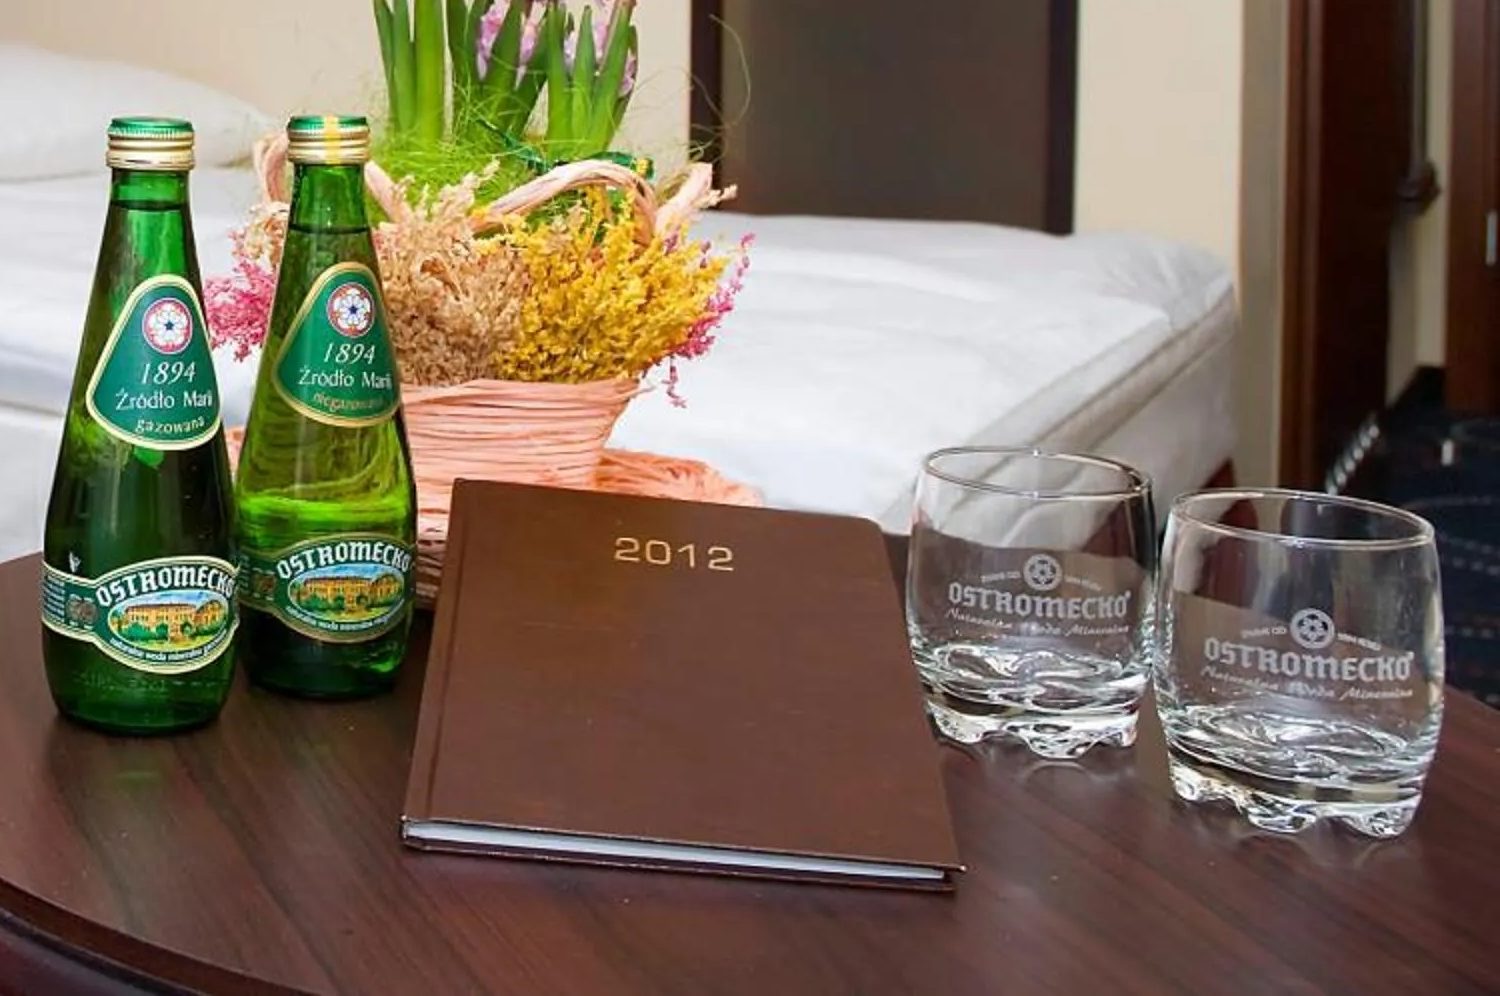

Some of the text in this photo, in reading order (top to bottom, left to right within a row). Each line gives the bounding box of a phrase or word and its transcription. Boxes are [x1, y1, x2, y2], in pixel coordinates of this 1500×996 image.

[323, 342, 376, 365] 1894
[141, 361, 197, 385] 1894
[135, 415, 206, 435] gazowana
[276, 541, 412, 580] OSTROMECKO
[613, 536, 735, 572] 2012
[94, 565, 235, 607] OSTROMECKO
[948, 581, 1129, 621] OSTROMECKO
[1203, 636, 1412, 683] OSTROMECKO
